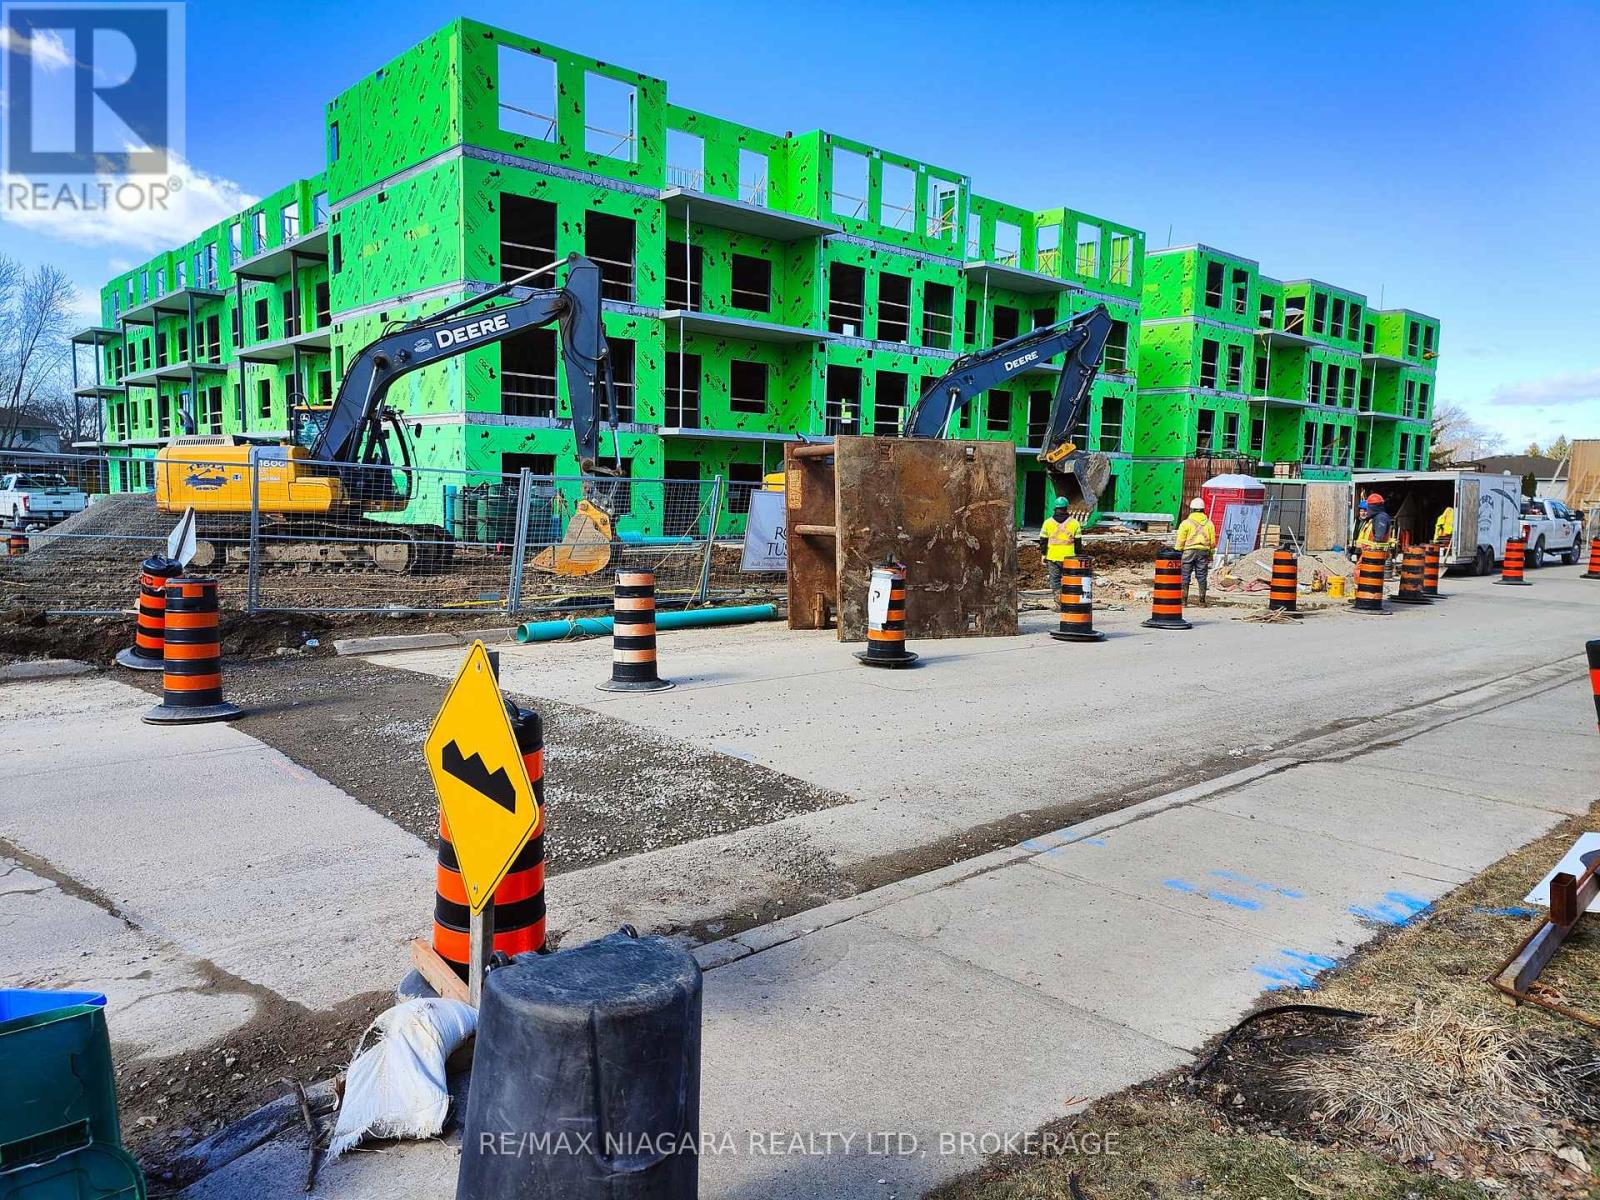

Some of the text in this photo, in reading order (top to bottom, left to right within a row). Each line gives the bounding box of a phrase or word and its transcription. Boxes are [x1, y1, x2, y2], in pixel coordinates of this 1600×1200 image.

[435, 314, 510, 349] DEERE
[1004, 350, 1039, 371] DEERE
[774, 526, 787, 540] R
